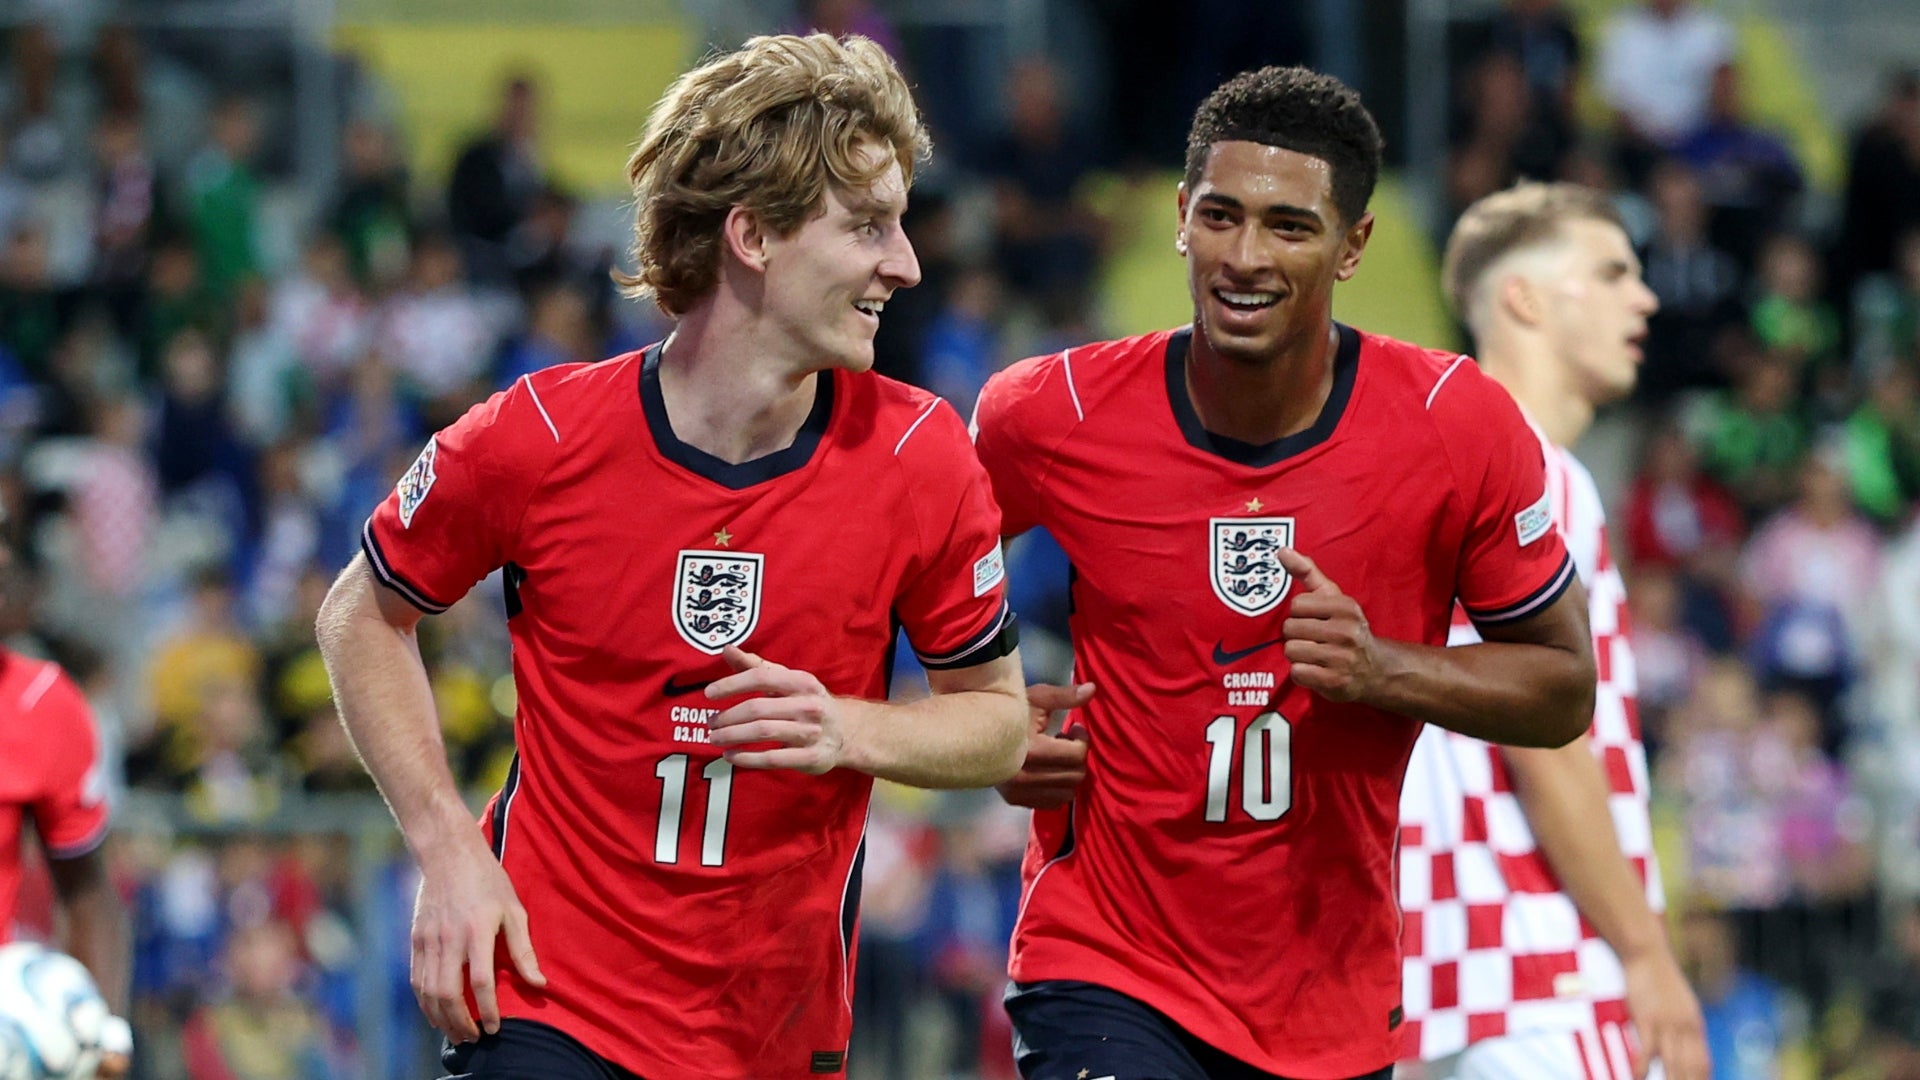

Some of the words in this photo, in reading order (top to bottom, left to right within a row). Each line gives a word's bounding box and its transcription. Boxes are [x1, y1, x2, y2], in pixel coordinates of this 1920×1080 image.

[1223, 672, 1274, 688] CROATIA
[671, 706, 719, 724] CROAT
[674, 726, 711, 743] 03.10.
[1205, 711, 1292, 822] 10
[654, 753, 735, 866] 11
